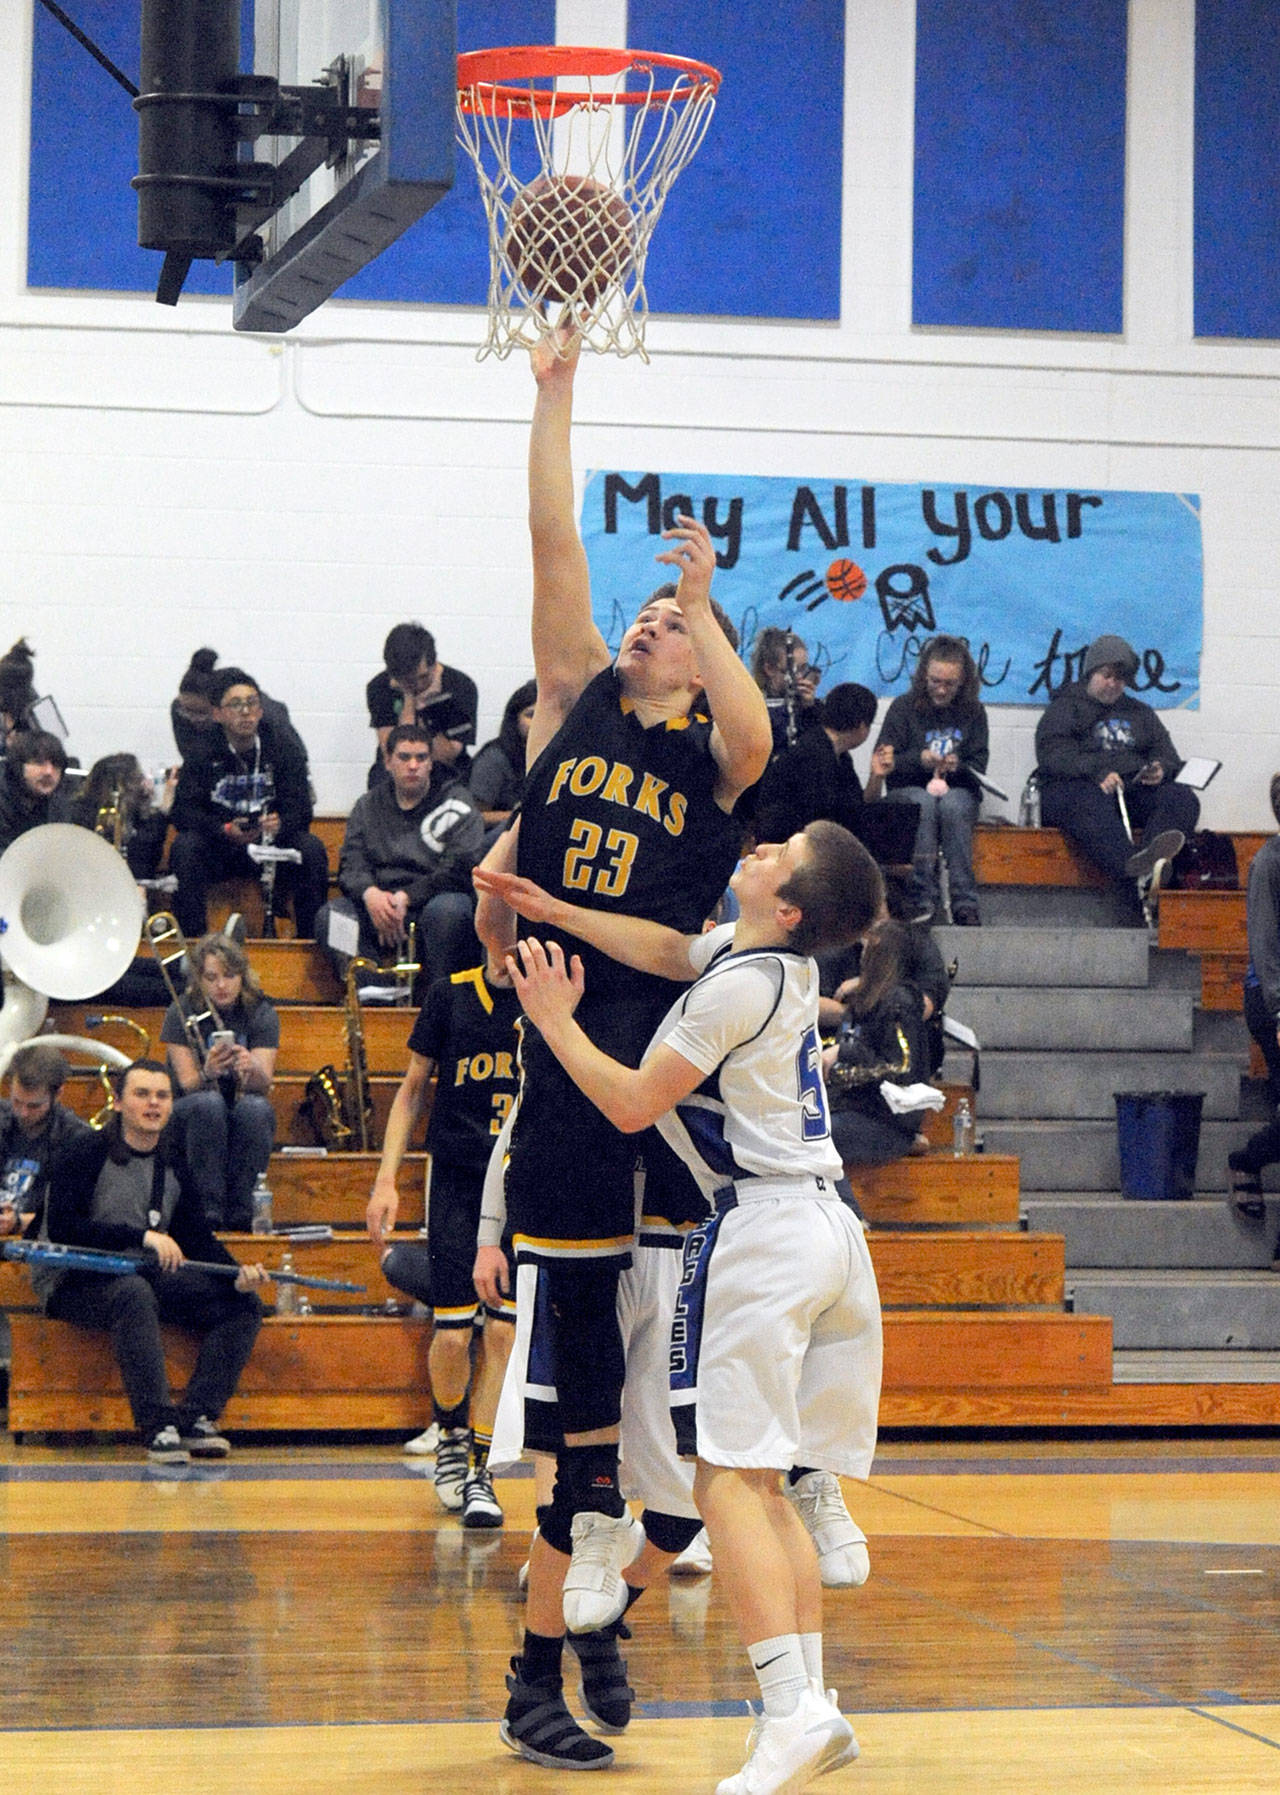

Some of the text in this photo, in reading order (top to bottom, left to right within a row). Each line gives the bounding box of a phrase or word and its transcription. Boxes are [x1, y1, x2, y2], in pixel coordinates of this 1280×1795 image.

[604, 473, 1103, 570] May All your
[875, 627, 1012, 687] Coe
[1027, 627, 1181, 696] tre
[545, 755, 689, 837] FORKS
[562, 817, 640, 898] 23
[454, 1051, 519, 1087] FOR
[796, 1023, 830, 1142] 5
